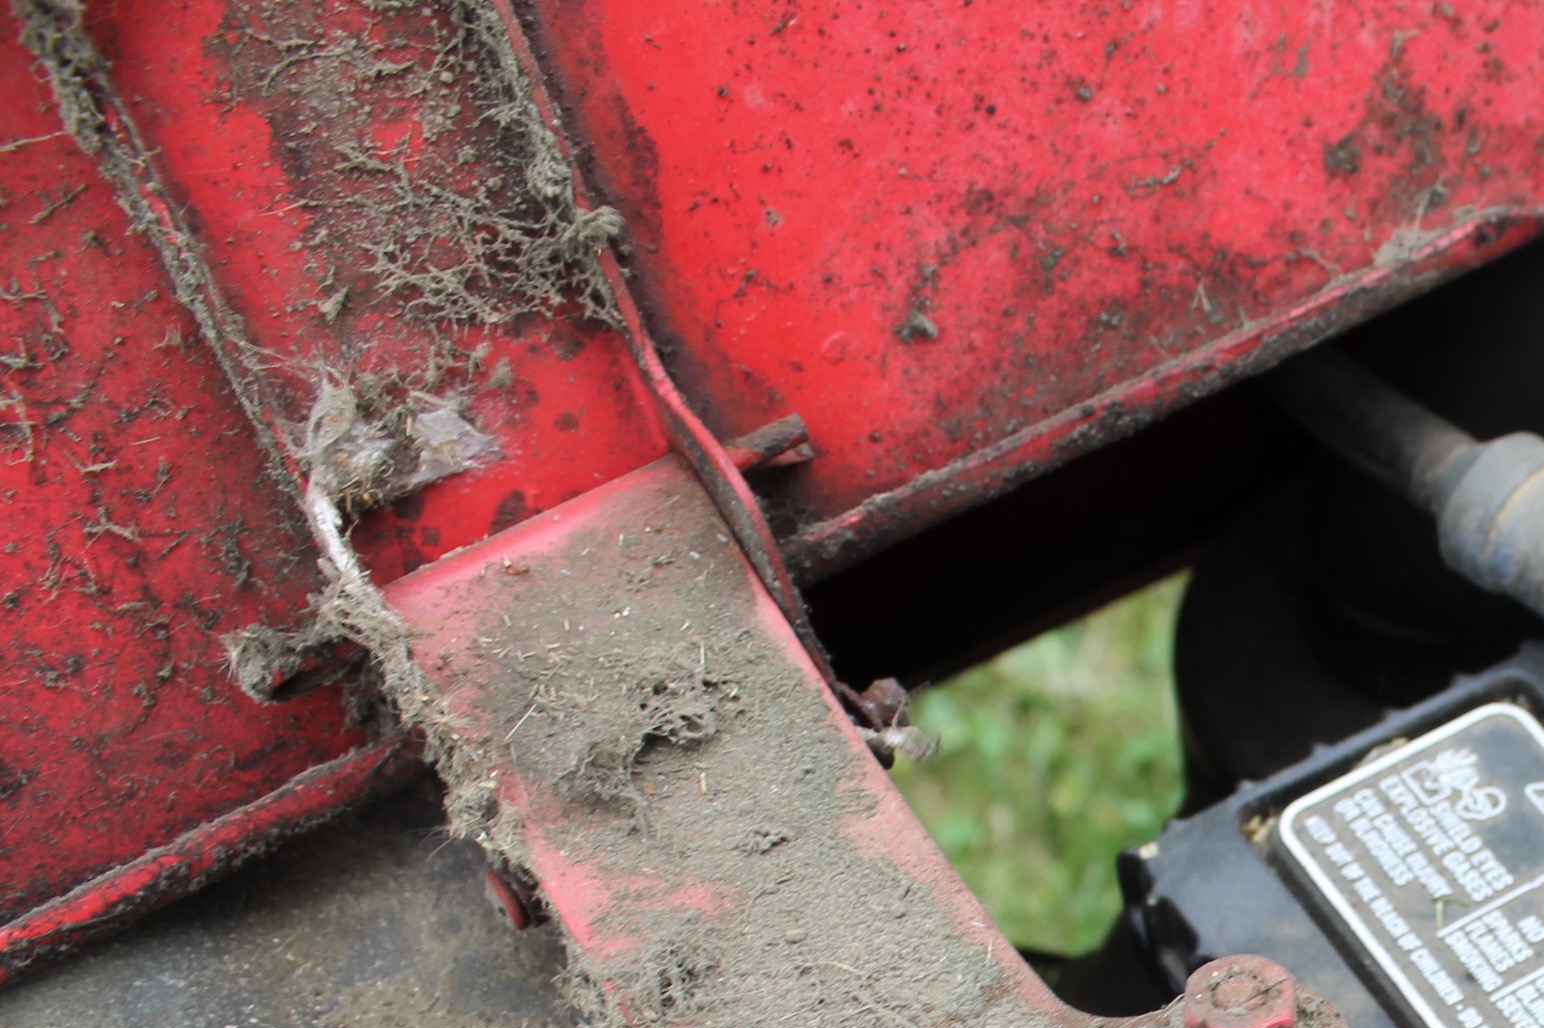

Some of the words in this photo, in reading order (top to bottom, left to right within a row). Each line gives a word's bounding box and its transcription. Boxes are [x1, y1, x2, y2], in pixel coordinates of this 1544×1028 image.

[1371, 812, 1418, 857] CAUSE
[1377, 773, 1456, 856] EXPLOSIVE
[1440, 849, 1494, 902] GASES
[1427, 799, 1483, 854] SHIELD
[1469, 848, 1515, 891] EYES
[1443, 928, 1504, 992] SMOKING
[1463, 918, 1515, 973] FLAMES
[1480, 909, 1534, 962] SPARKS
[1408, 946, 1464, 1006] CHILDREN
